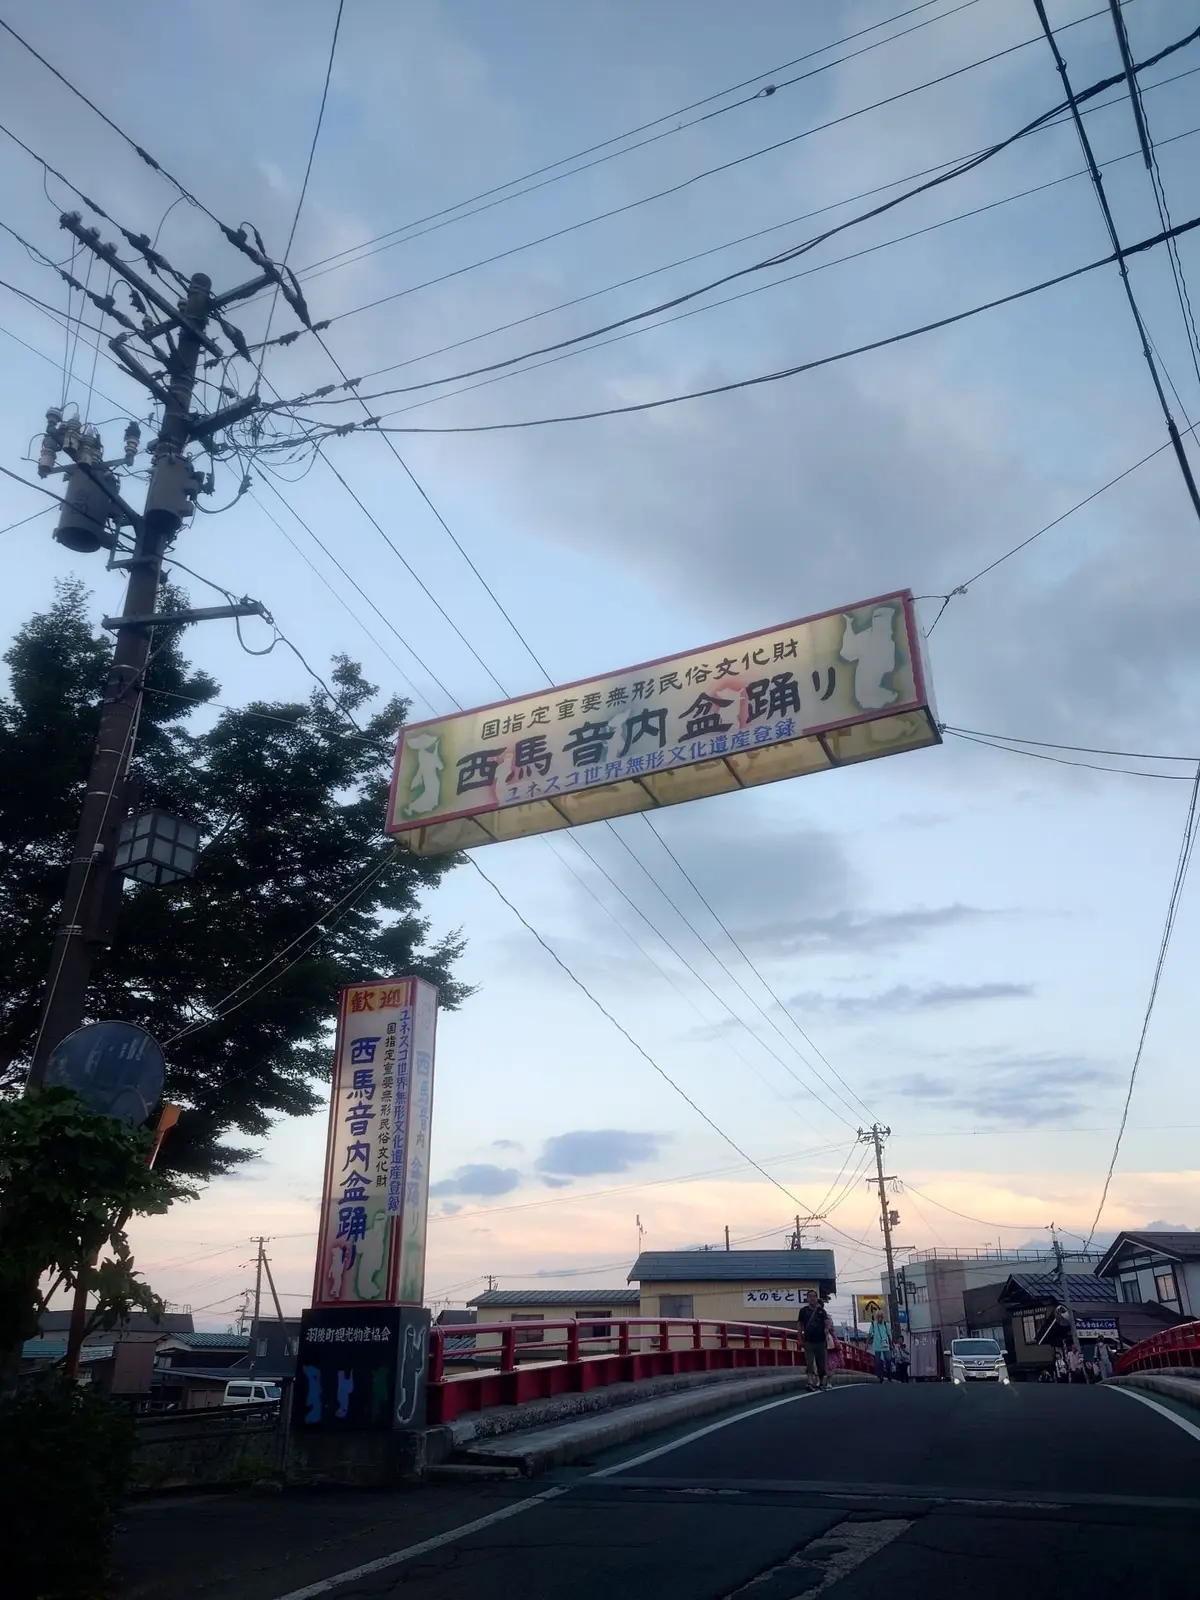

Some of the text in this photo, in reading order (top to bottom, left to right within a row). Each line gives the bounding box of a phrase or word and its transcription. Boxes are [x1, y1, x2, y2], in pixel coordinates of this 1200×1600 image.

[456, 667, 836, 796] 西馬音内盆踊り
[481, 638, 799, 740] 国指定重要無形民俗文化財
[505, 717, 796, 802] ユネスコ世界無形文化遺産登録
[350, 988, 401, 1013] 歓迎
[336, 1036, 382, 1271] 西馬音内盆踊り
[375, 1022, 397, 1188] 国指定重要無形民俗文化財
